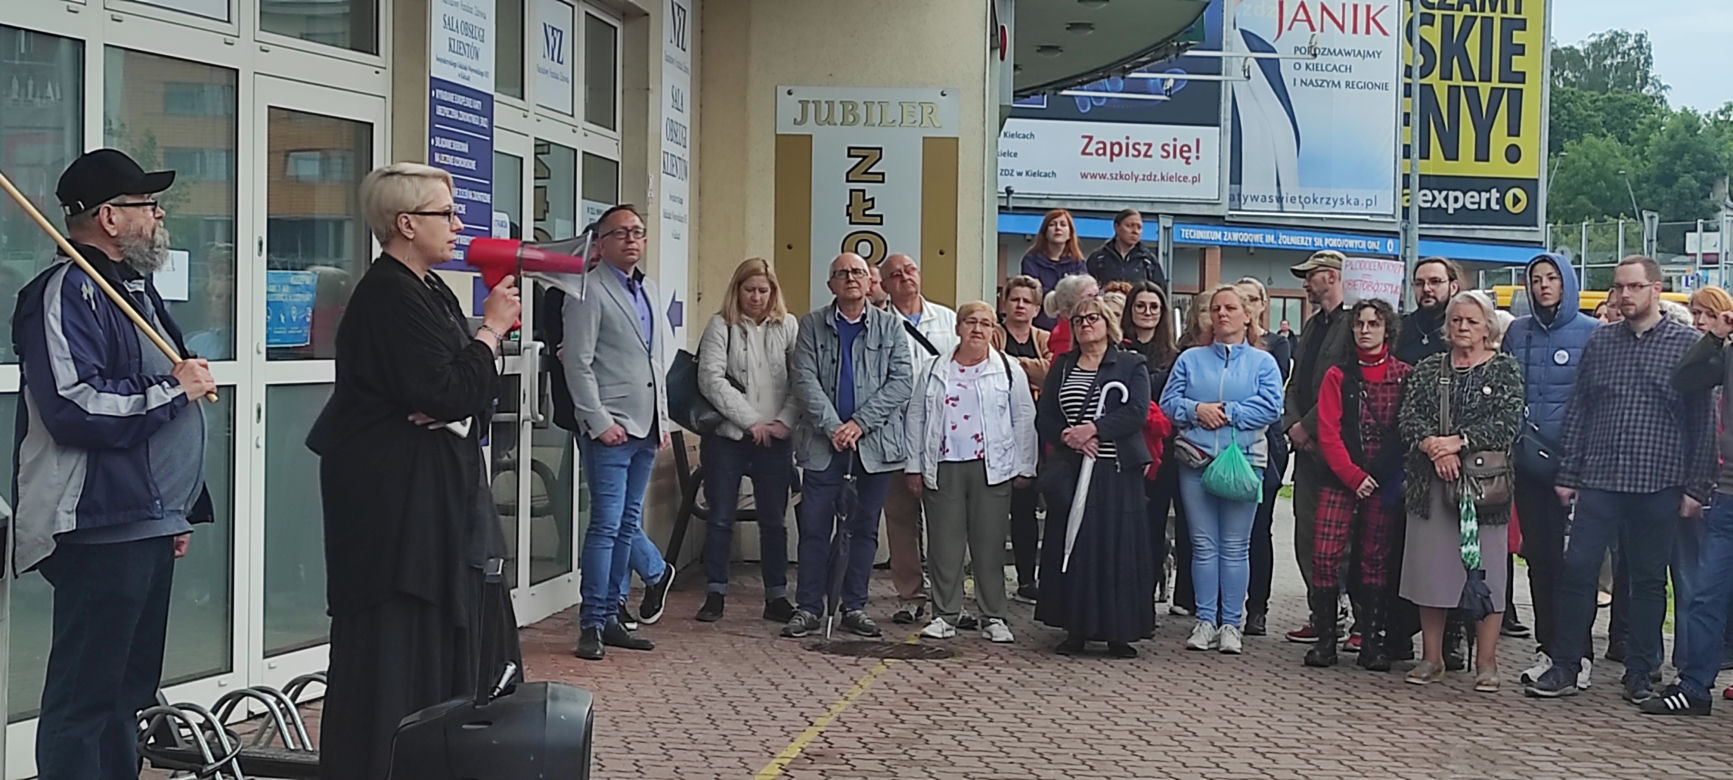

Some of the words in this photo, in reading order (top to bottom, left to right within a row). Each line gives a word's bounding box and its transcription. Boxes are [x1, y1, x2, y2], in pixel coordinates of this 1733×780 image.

[442, 13, 459, 34] SALA
[460, 19, 485, 43] OBSŁUGI
[1273, 0, 1391, 43] JANIK
[448, 36, 480, 61] KLIENTÓW
[542, 21, 564, 65] NFZ
[1404, 12, 1527, 85] SKIE
[1293, 62, 1302, 71] O
[1305, 62, 1353, 73] KIELCACH
[671, 84, 684, 113] SALA
[1293, 77, 1297, 87] I
[1300, 78, 1341, 89] NASZYM
[1345, 81, 1390, 91] REGIONIE
[793, 99, 943, 129] JUBILER
[1003, 131, 1035, 140] Kielcach
[1080, 134, 1153, 163] Zapisz
[1160, 137, 1201, 166] się!
[662, 150, 688, 182] KLIENTÓW
[1025, 170, 1057, 179] Kielcach
[1079, 171, 1201, 185] www.szkoly.zdz.kielce.pl
[1180, 228, 1221, 241] TECHNIKUM
[1223, 231, 1264, 244] ZAWODOWE
[1325, 237, 1366, 250] POKOJOWYCH
